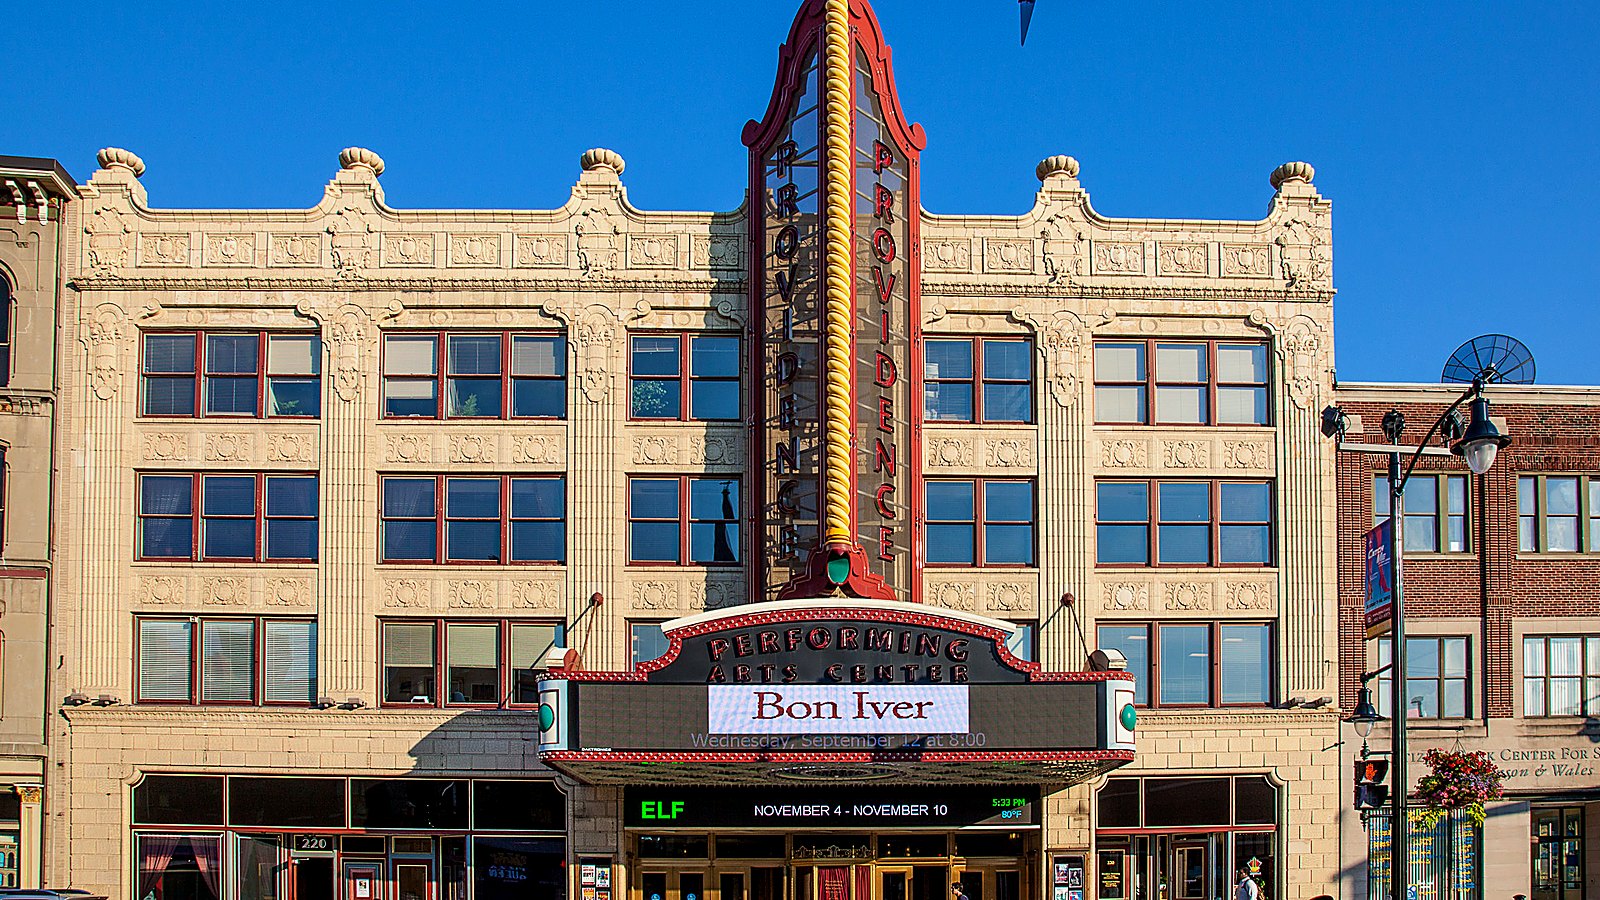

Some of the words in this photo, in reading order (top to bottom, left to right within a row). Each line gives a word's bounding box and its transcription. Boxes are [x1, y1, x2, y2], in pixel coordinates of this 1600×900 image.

[775, 140, 801, 562] PROVIDENCE
[871, 139, 897, 563] PROVIDENCE
[706, 626, 969, 662] PERFORMING
[706, 663, 798, 682] ARTS
[825, 663, 969, 682] CENTER
[752, 691, 842, 719] Bon
[852, 691, 934, 719] Iver
[690, 733, 795, 749] Wednesday,
[801, 733, 895, 749] September
[902, 733, 920, 747] 12
[926, 734, 944, 747] at
[949, 732, 986, 747] 8:00
[1534, 764, 1547, 777] &
[1552, 763, 1594, 777] Wales
[641, 801, 685, 819] ELF
[754, 805, 830, 816] NOVEMBER
[833, 805, 841, 816] 4
[853, 804, 929, 816] NOVEMBER
[933, 804, 948, 816] 10
[992, 798, 1011, 807] 5:33
[1013, 798, 1025, 807] PM
[301, 838, 327, 849] 220
